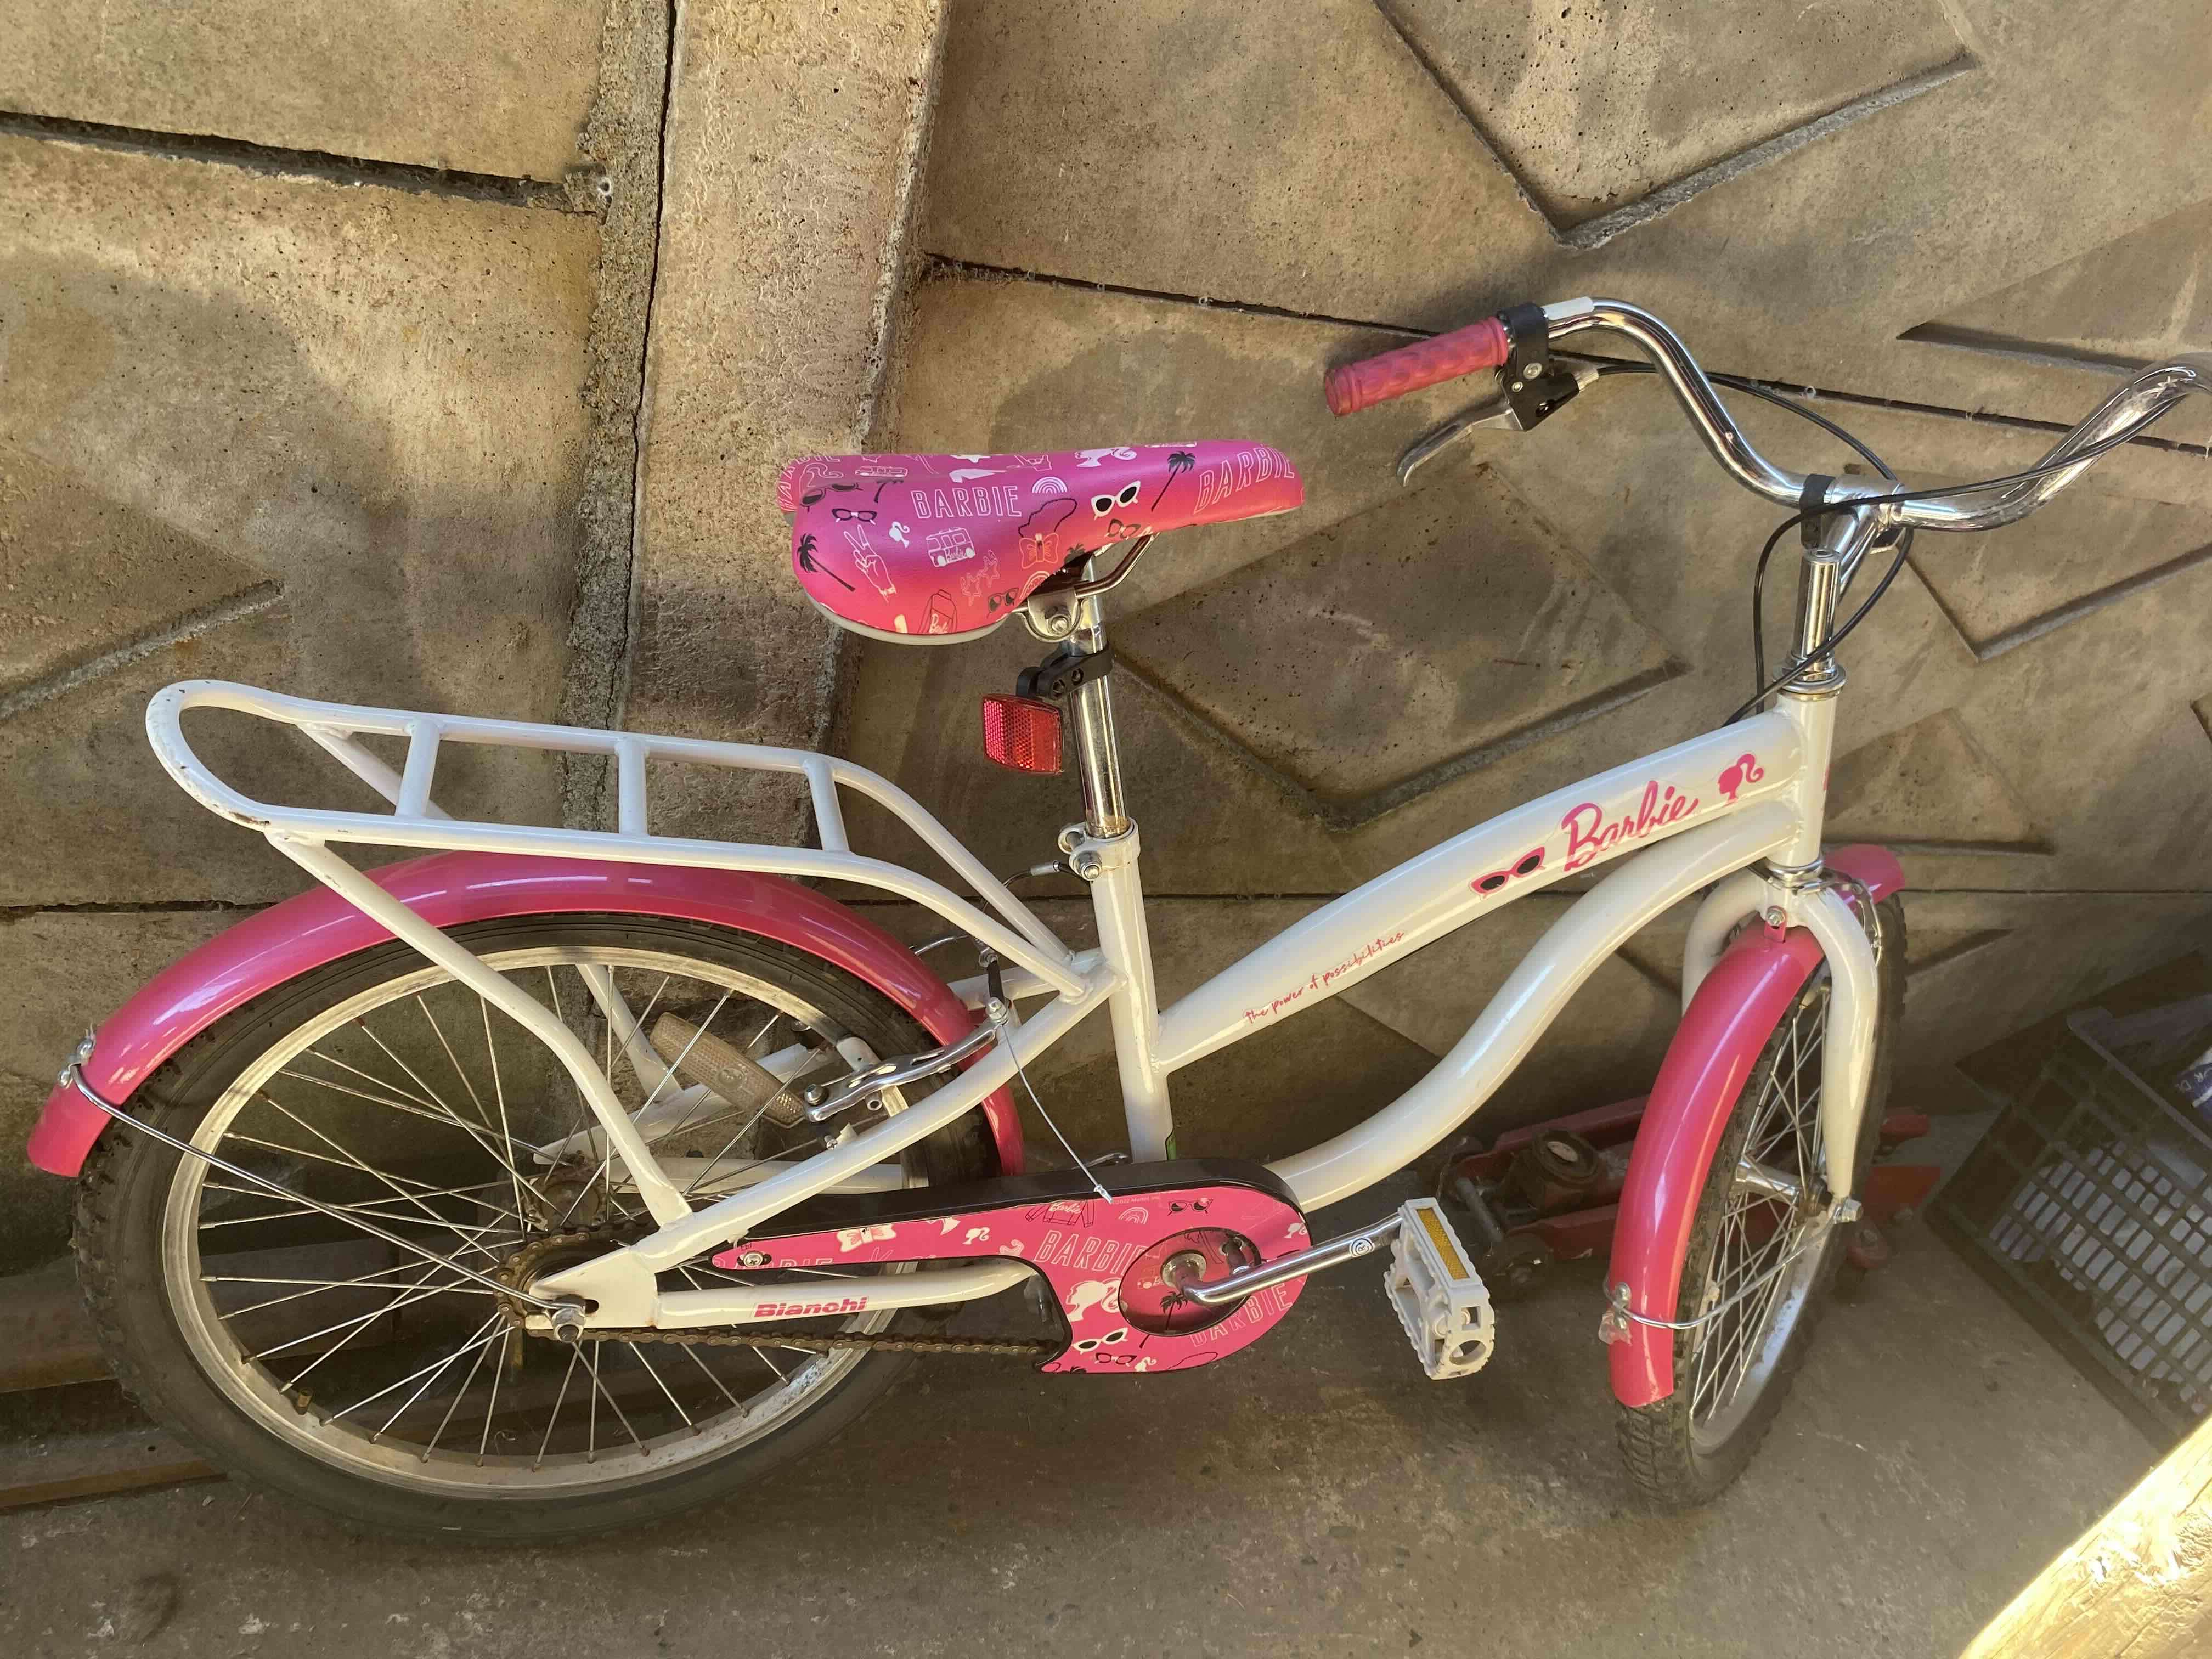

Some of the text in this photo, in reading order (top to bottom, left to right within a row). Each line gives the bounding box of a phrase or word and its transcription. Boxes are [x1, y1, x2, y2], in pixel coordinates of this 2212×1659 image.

[911, 486, 1022, 518] BARBIE
[1561, 780, 1699, 871] Barbie
[1272, 987, 1304, 1014] power
[1322, 932, 1404, 986] possibilities
[754, 1296, 868, 1317] Bianchi
